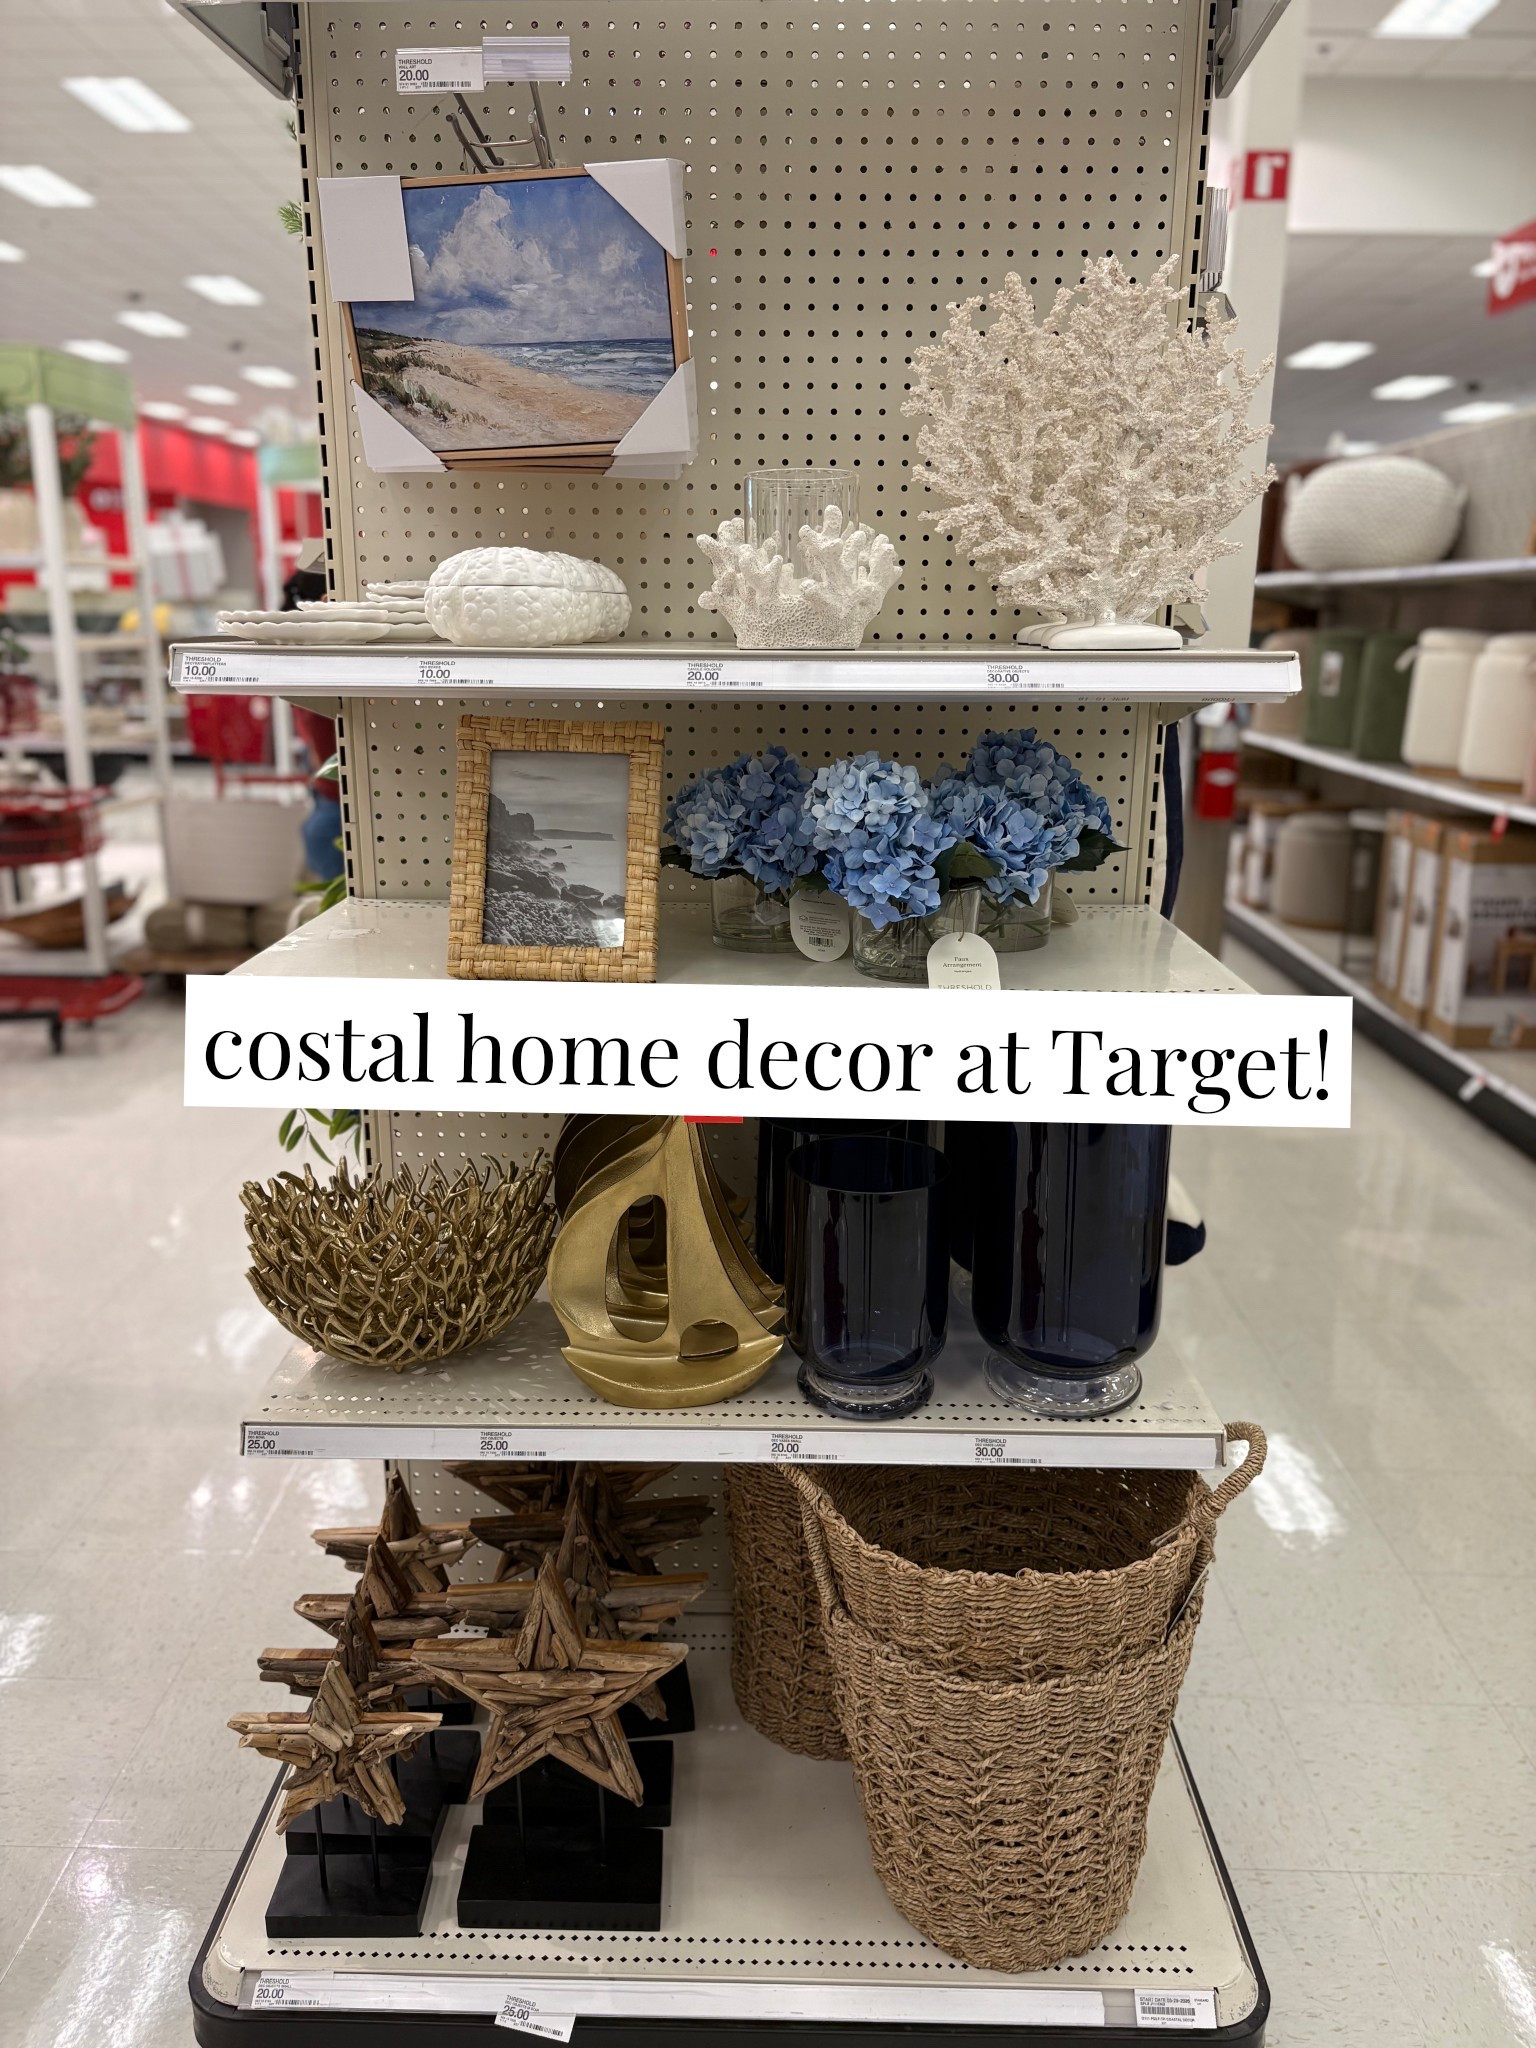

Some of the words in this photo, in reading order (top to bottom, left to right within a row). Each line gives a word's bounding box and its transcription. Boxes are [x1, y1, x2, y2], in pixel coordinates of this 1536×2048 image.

[399, 69, 429, 81] 20.00
[185, 665, 216, 676] 10.00
[420, 669, 451, 679] 10.00
[687, 671, 719, 681] 20.00
[987, 673, 1020, 683] 30.00
[247, 1439, 276, 1449] 25.00
[480, 1440, 508, 1450] 25.00
[771, 1442, 799, 1453] 20.00
[975, 1446, 1003, 1457] 30.00
[256, 1988, 284, 1999] 20.00
[506, 1994, 537, 2007] THRESHOLD
[502, 2004, 530, 2021] 25.00
